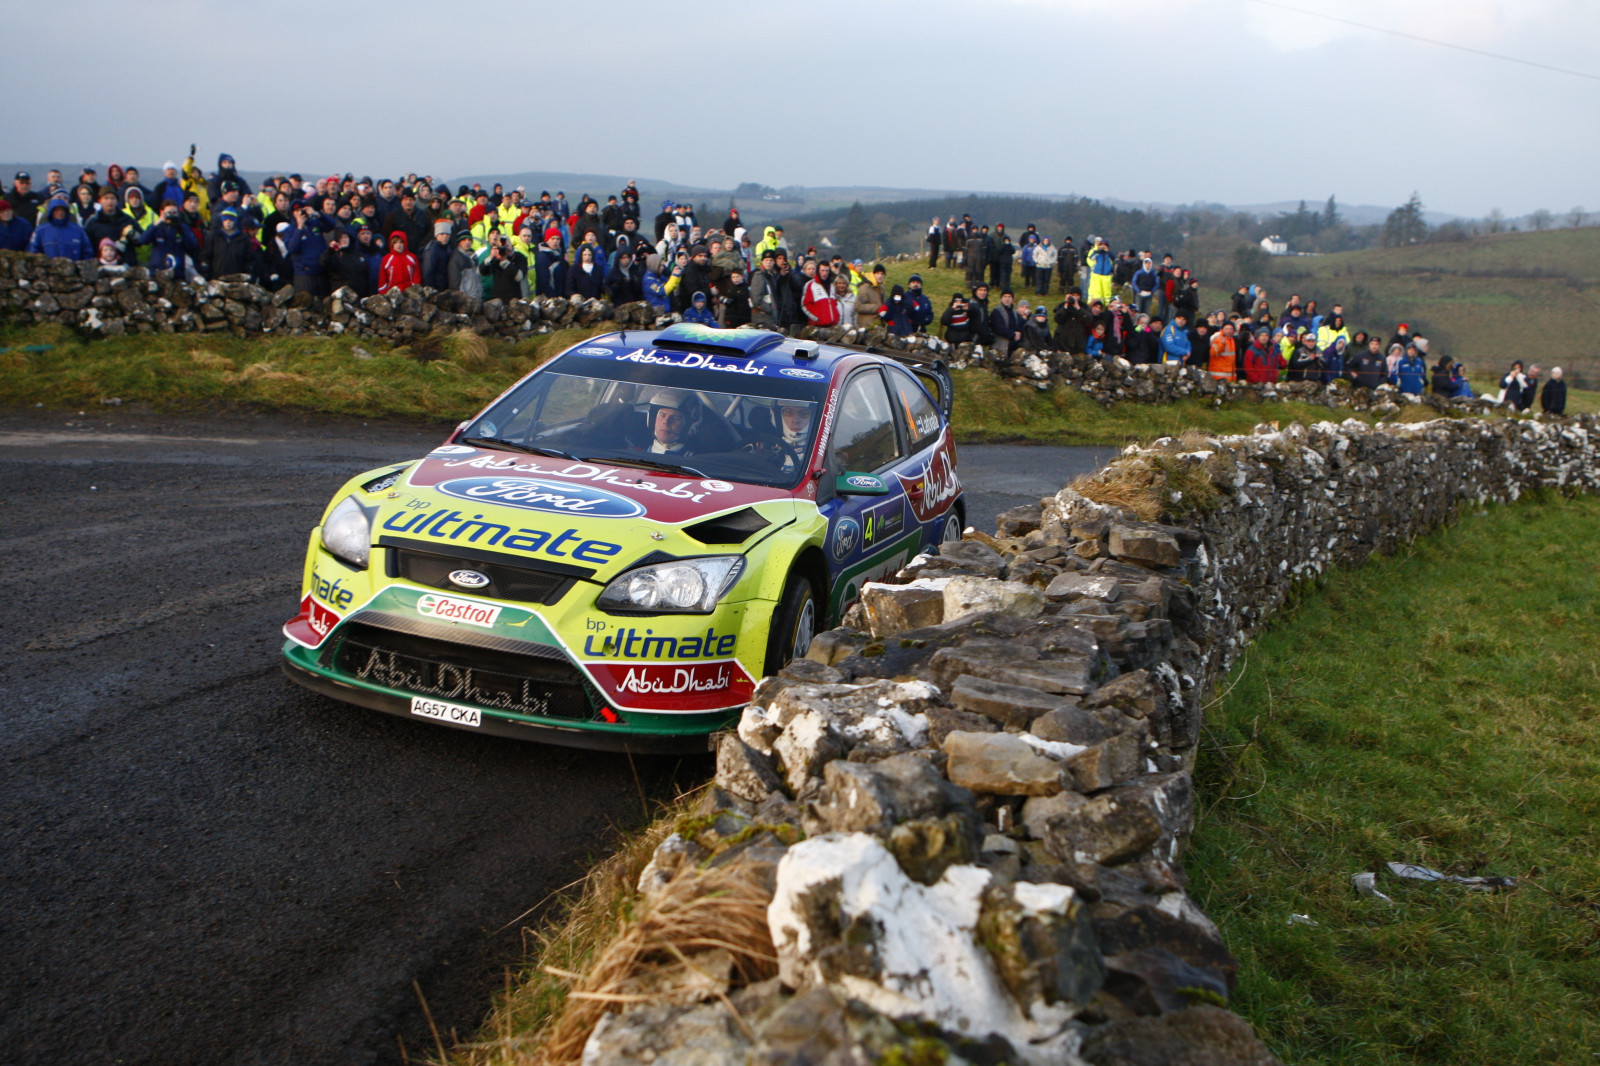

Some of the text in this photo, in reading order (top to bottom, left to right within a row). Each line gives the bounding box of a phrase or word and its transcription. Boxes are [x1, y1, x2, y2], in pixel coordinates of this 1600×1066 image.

[616, 348, 768, 376] Abu Dhabi
[405, 498, 431, 511] bp
[466, 478, 610, 511] Ford
[382, 509, 623, 564] ultimate
[865, 517, 873, 541] 4
[435, 599, 495, 624] Castrol
[586, 617, 607, 633] bp
[584, 627, 737, 658] ultimate
[616, 665, 731, 694] Abu Dhabi
[413, 699, 479, 725] AG57 CKA
